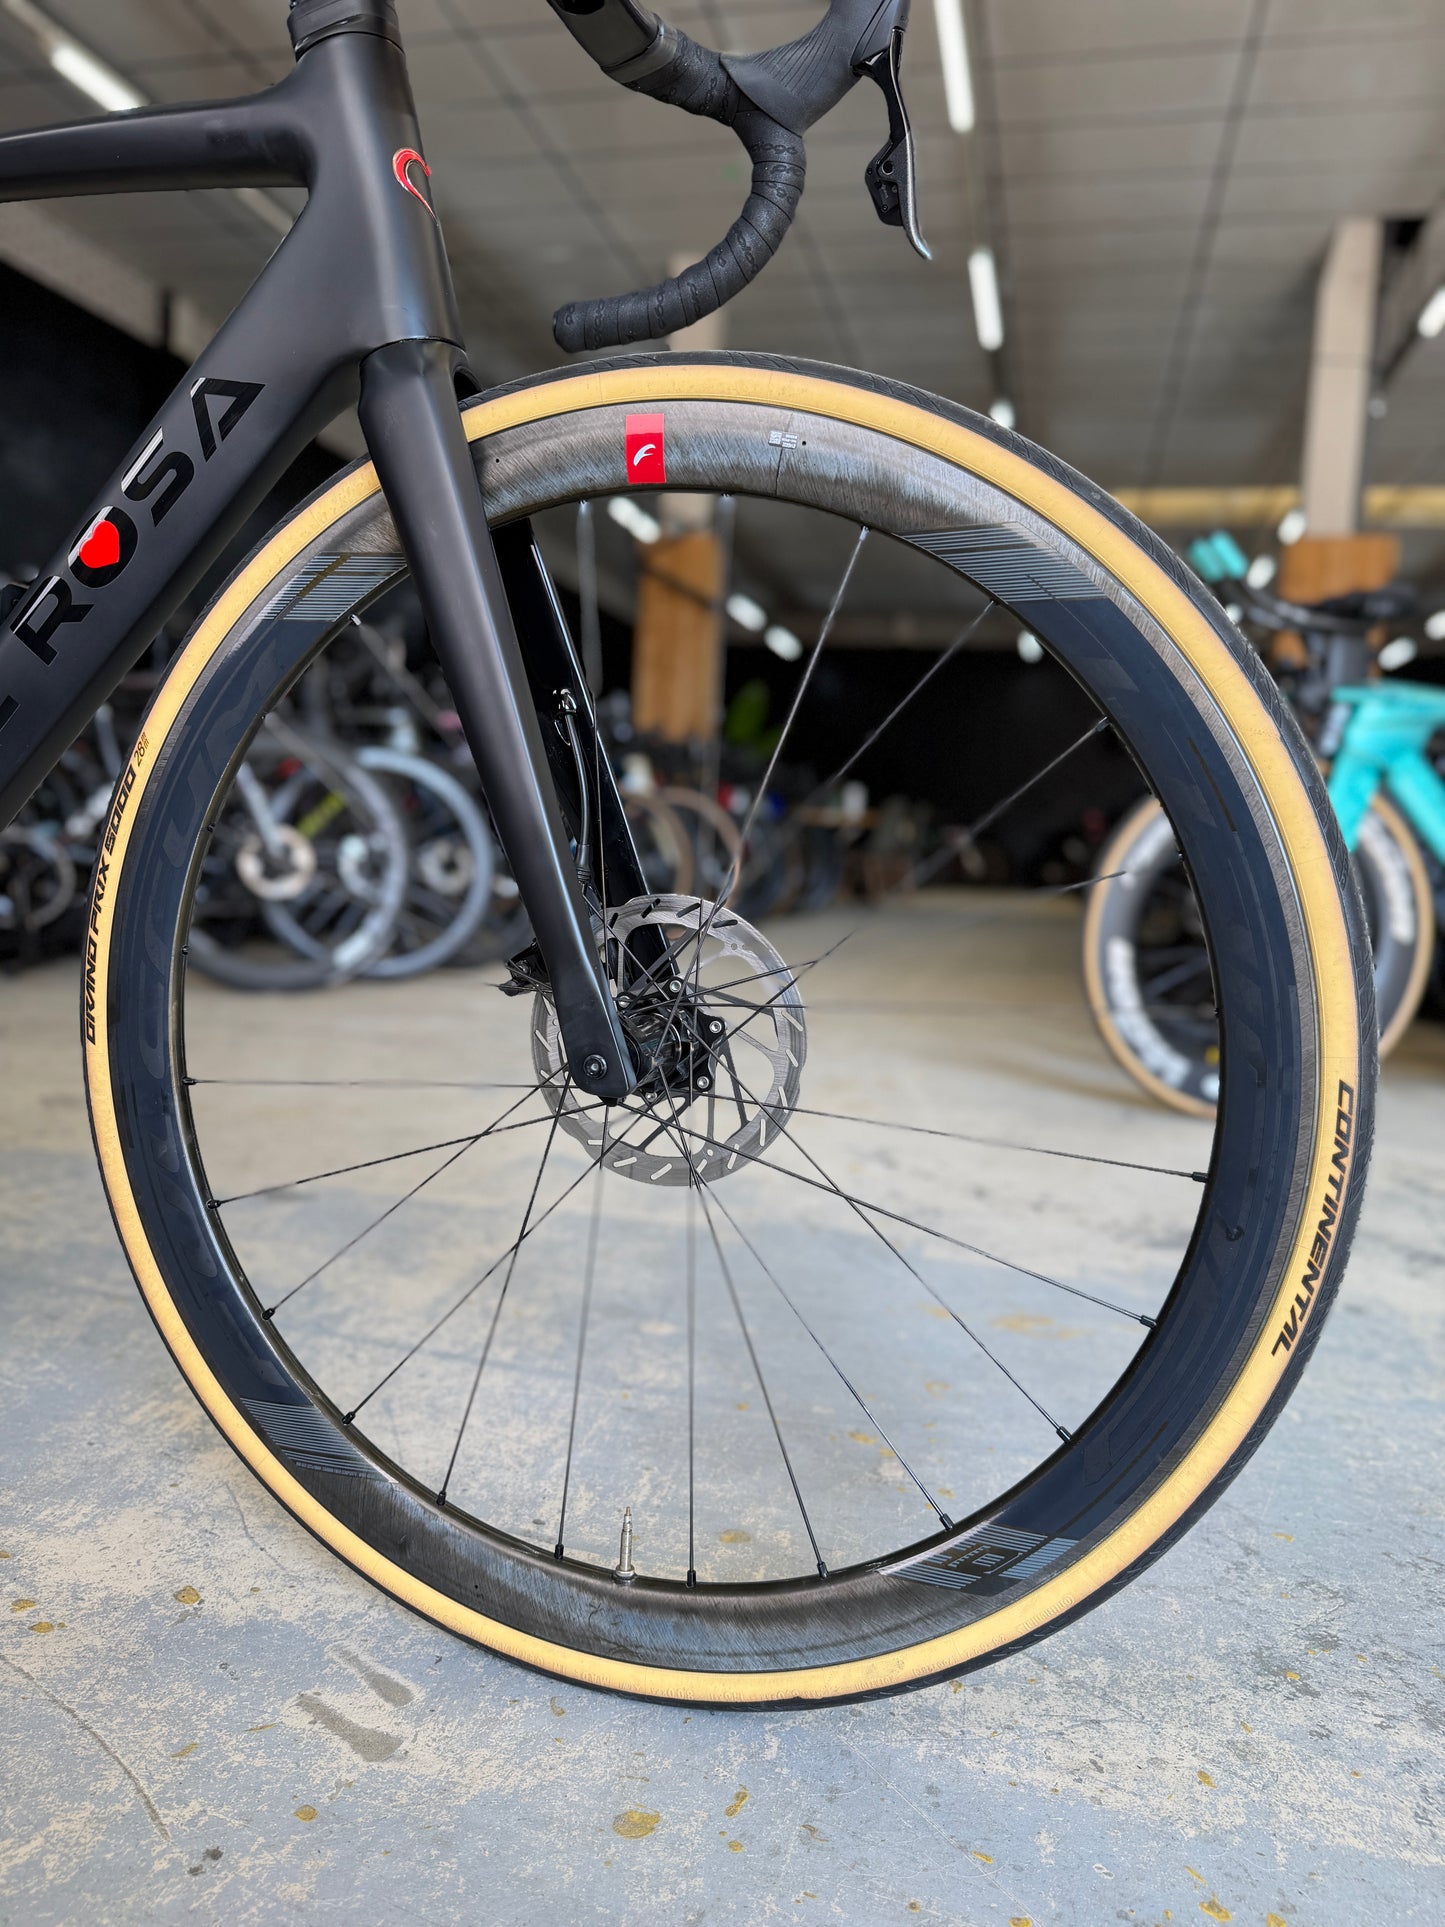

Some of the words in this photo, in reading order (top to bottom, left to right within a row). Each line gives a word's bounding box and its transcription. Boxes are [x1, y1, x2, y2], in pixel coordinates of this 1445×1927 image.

[10, 376, 266, 666] ROSA
[105, 763, 136, 856] 5000
[89, 854, 110, 936] PRIX
[86, 940, 98, 1046] GRAND
[1271, 1079, 1354, 1356] CONTINENTAL
